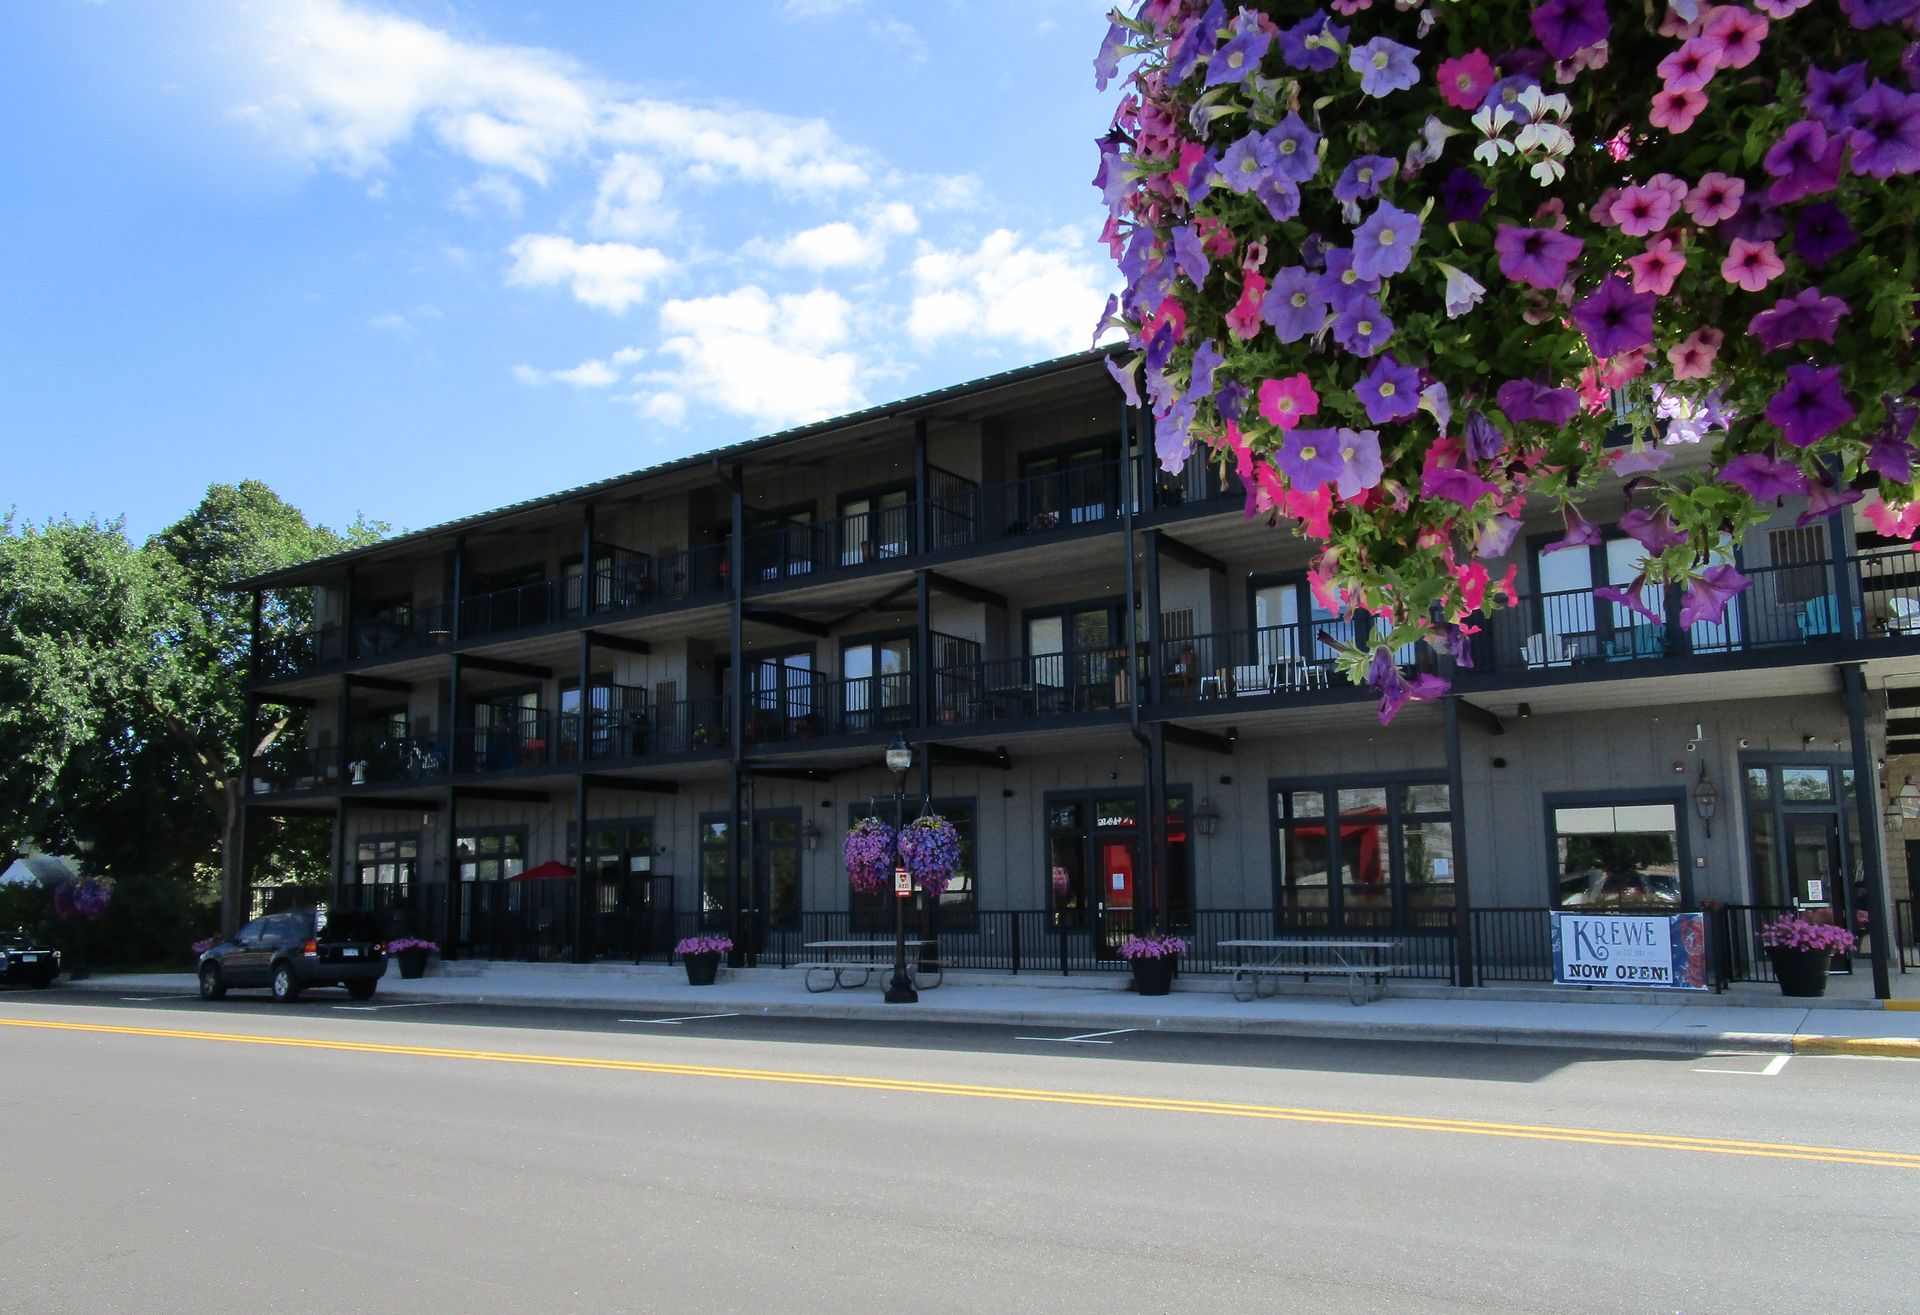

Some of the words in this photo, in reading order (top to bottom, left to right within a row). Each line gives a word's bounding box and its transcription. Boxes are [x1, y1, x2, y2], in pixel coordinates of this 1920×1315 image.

[1573, 920, 1657, 961] KREWE
[1568, 964, 1608, 979] NOW
[1616, 965, 1669, 981] OPEN!
